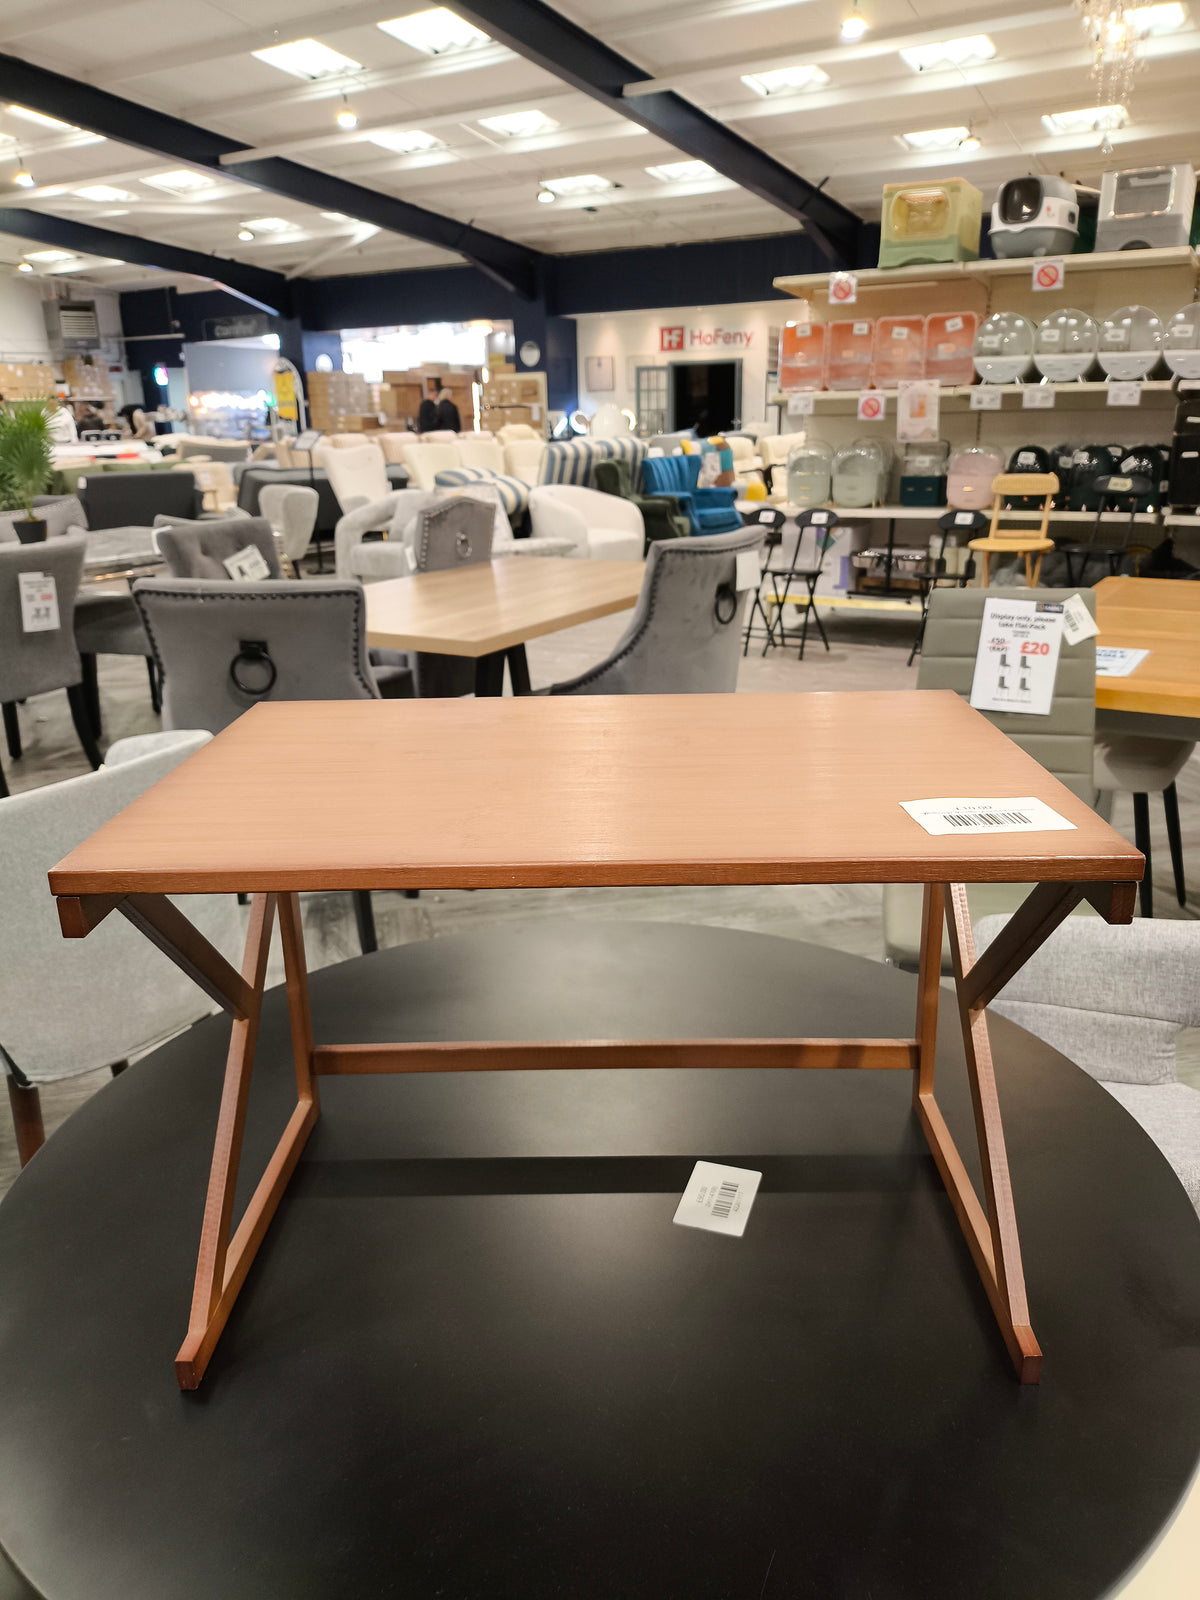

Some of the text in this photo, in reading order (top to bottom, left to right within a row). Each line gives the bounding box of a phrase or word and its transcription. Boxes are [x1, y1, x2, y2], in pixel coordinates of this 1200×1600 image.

[690, 328, 753, 348] HoFeny
[990, 613, 1014, 621] Display
[1020, 641, 1050, 656] £20
